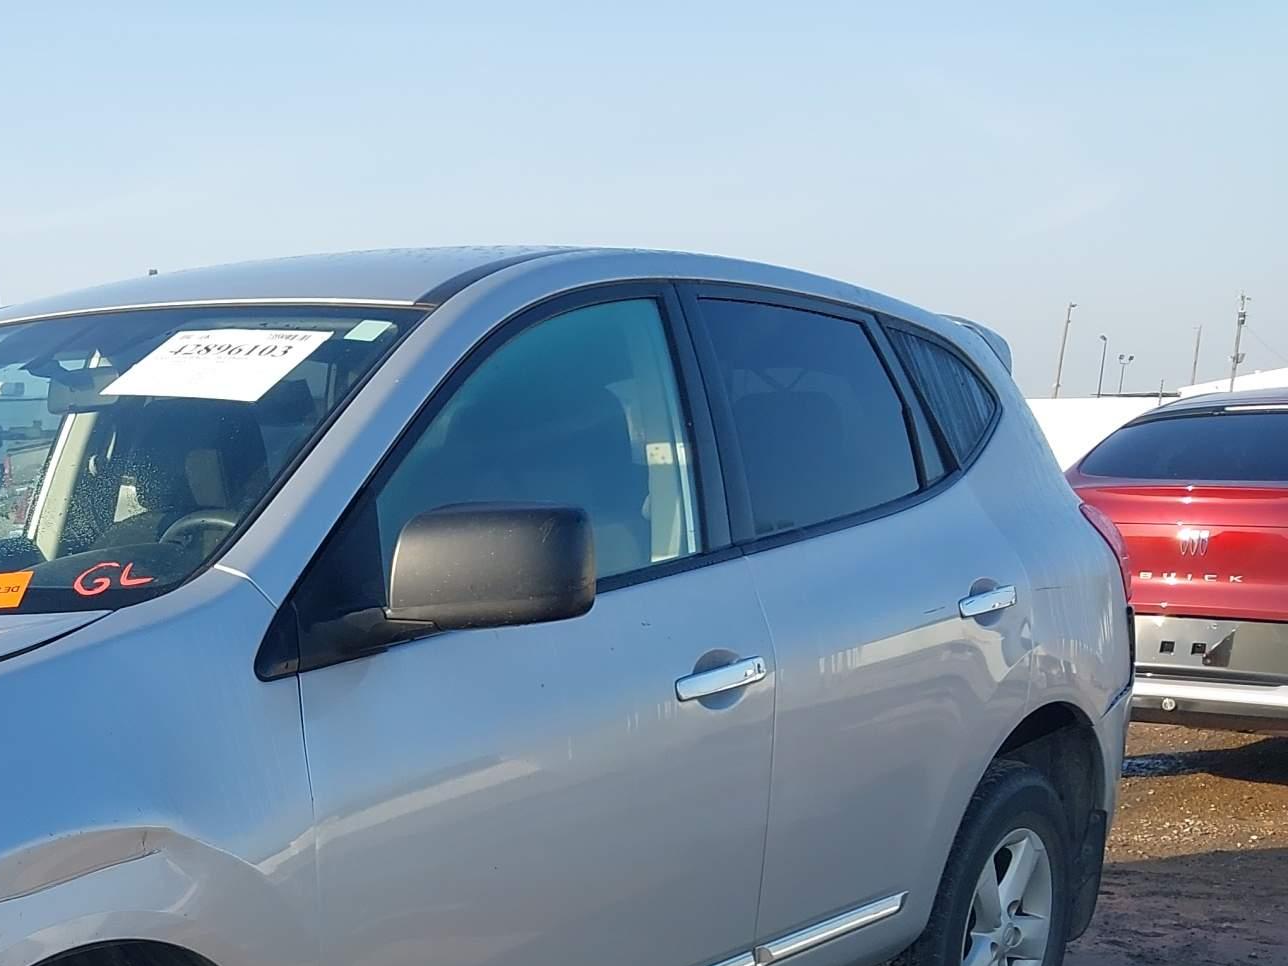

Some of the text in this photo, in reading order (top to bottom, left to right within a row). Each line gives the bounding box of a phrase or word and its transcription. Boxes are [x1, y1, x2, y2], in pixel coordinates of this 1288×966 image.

[168, 343, 293, 358] 42896103
[73, 561, 155, 596] GL
[1138, 571, 1244, 585] BUICK
